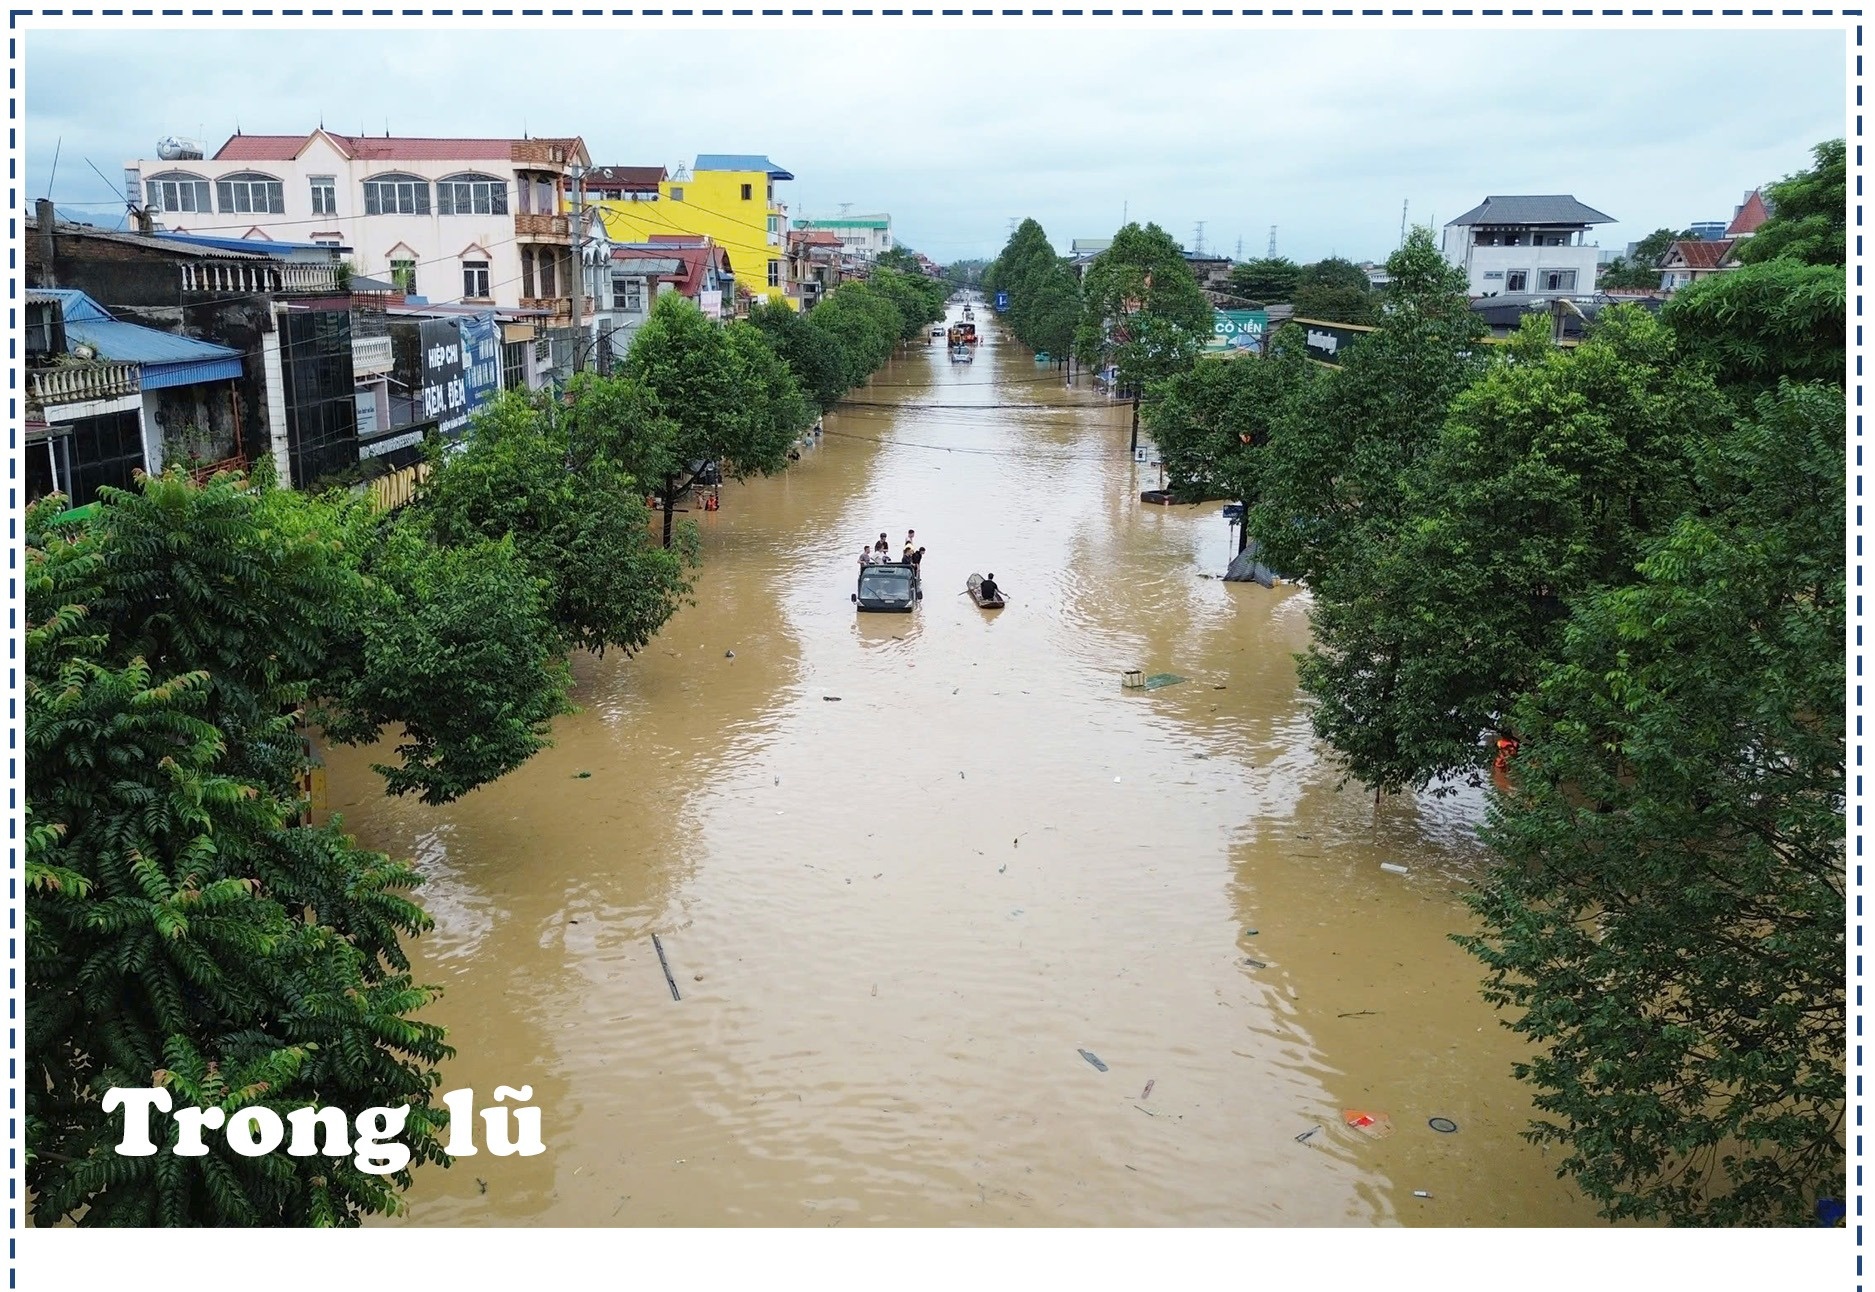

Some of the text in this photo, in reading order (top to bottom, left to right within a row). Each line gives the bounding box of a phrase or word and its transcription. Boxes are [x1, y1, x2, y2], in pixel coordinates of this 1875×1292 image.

[428, 343, 445, 372] HIỆP
[446, 344, 458, 365] CHI
[448, 374, 466, 413] ĐỆM
